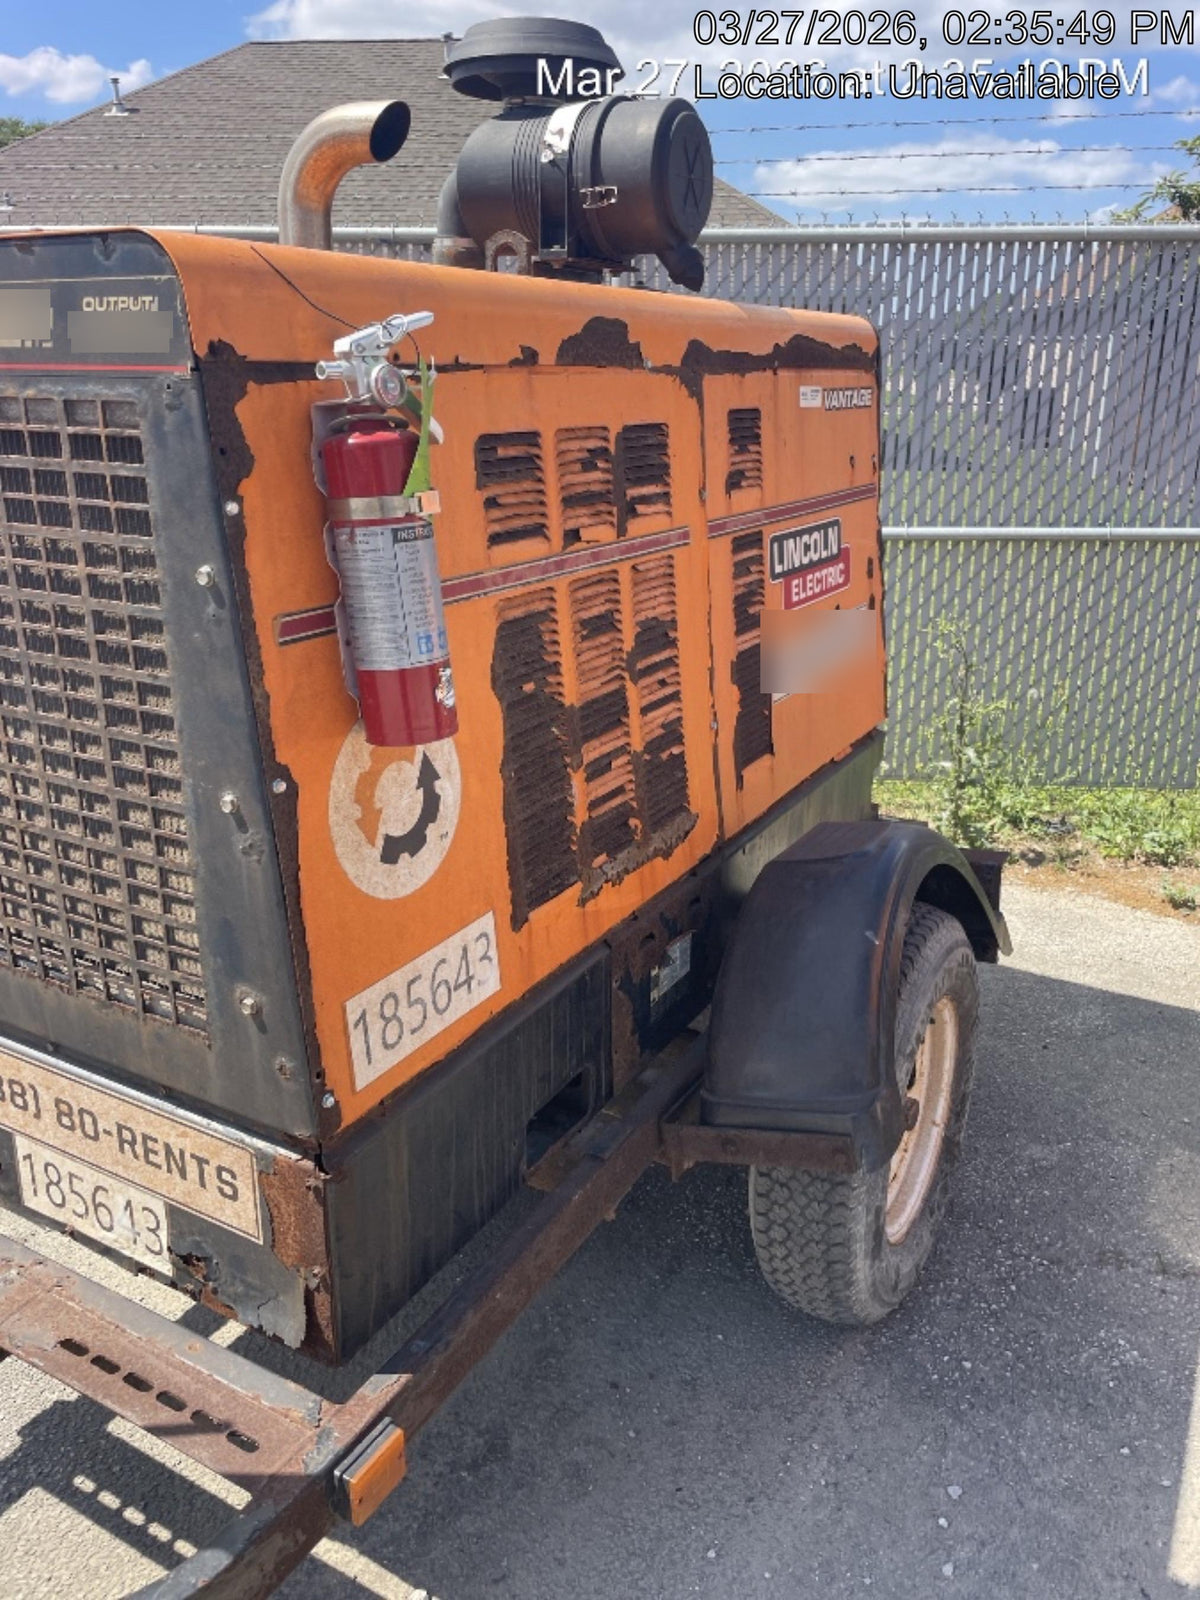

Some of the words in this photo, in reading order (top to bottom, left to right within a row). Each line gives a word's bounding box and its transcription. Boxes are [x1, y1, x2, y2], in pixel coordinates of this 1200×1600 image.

[824, 388, 872, 410] VANTAGE
[773, 525, 839, 575] LINCOLN
[791, 562, 846, 602] ELECTRIC
[353, 931, 493, 1066] 185643
[53, 1096, 240, 1203] 80-RENTS
